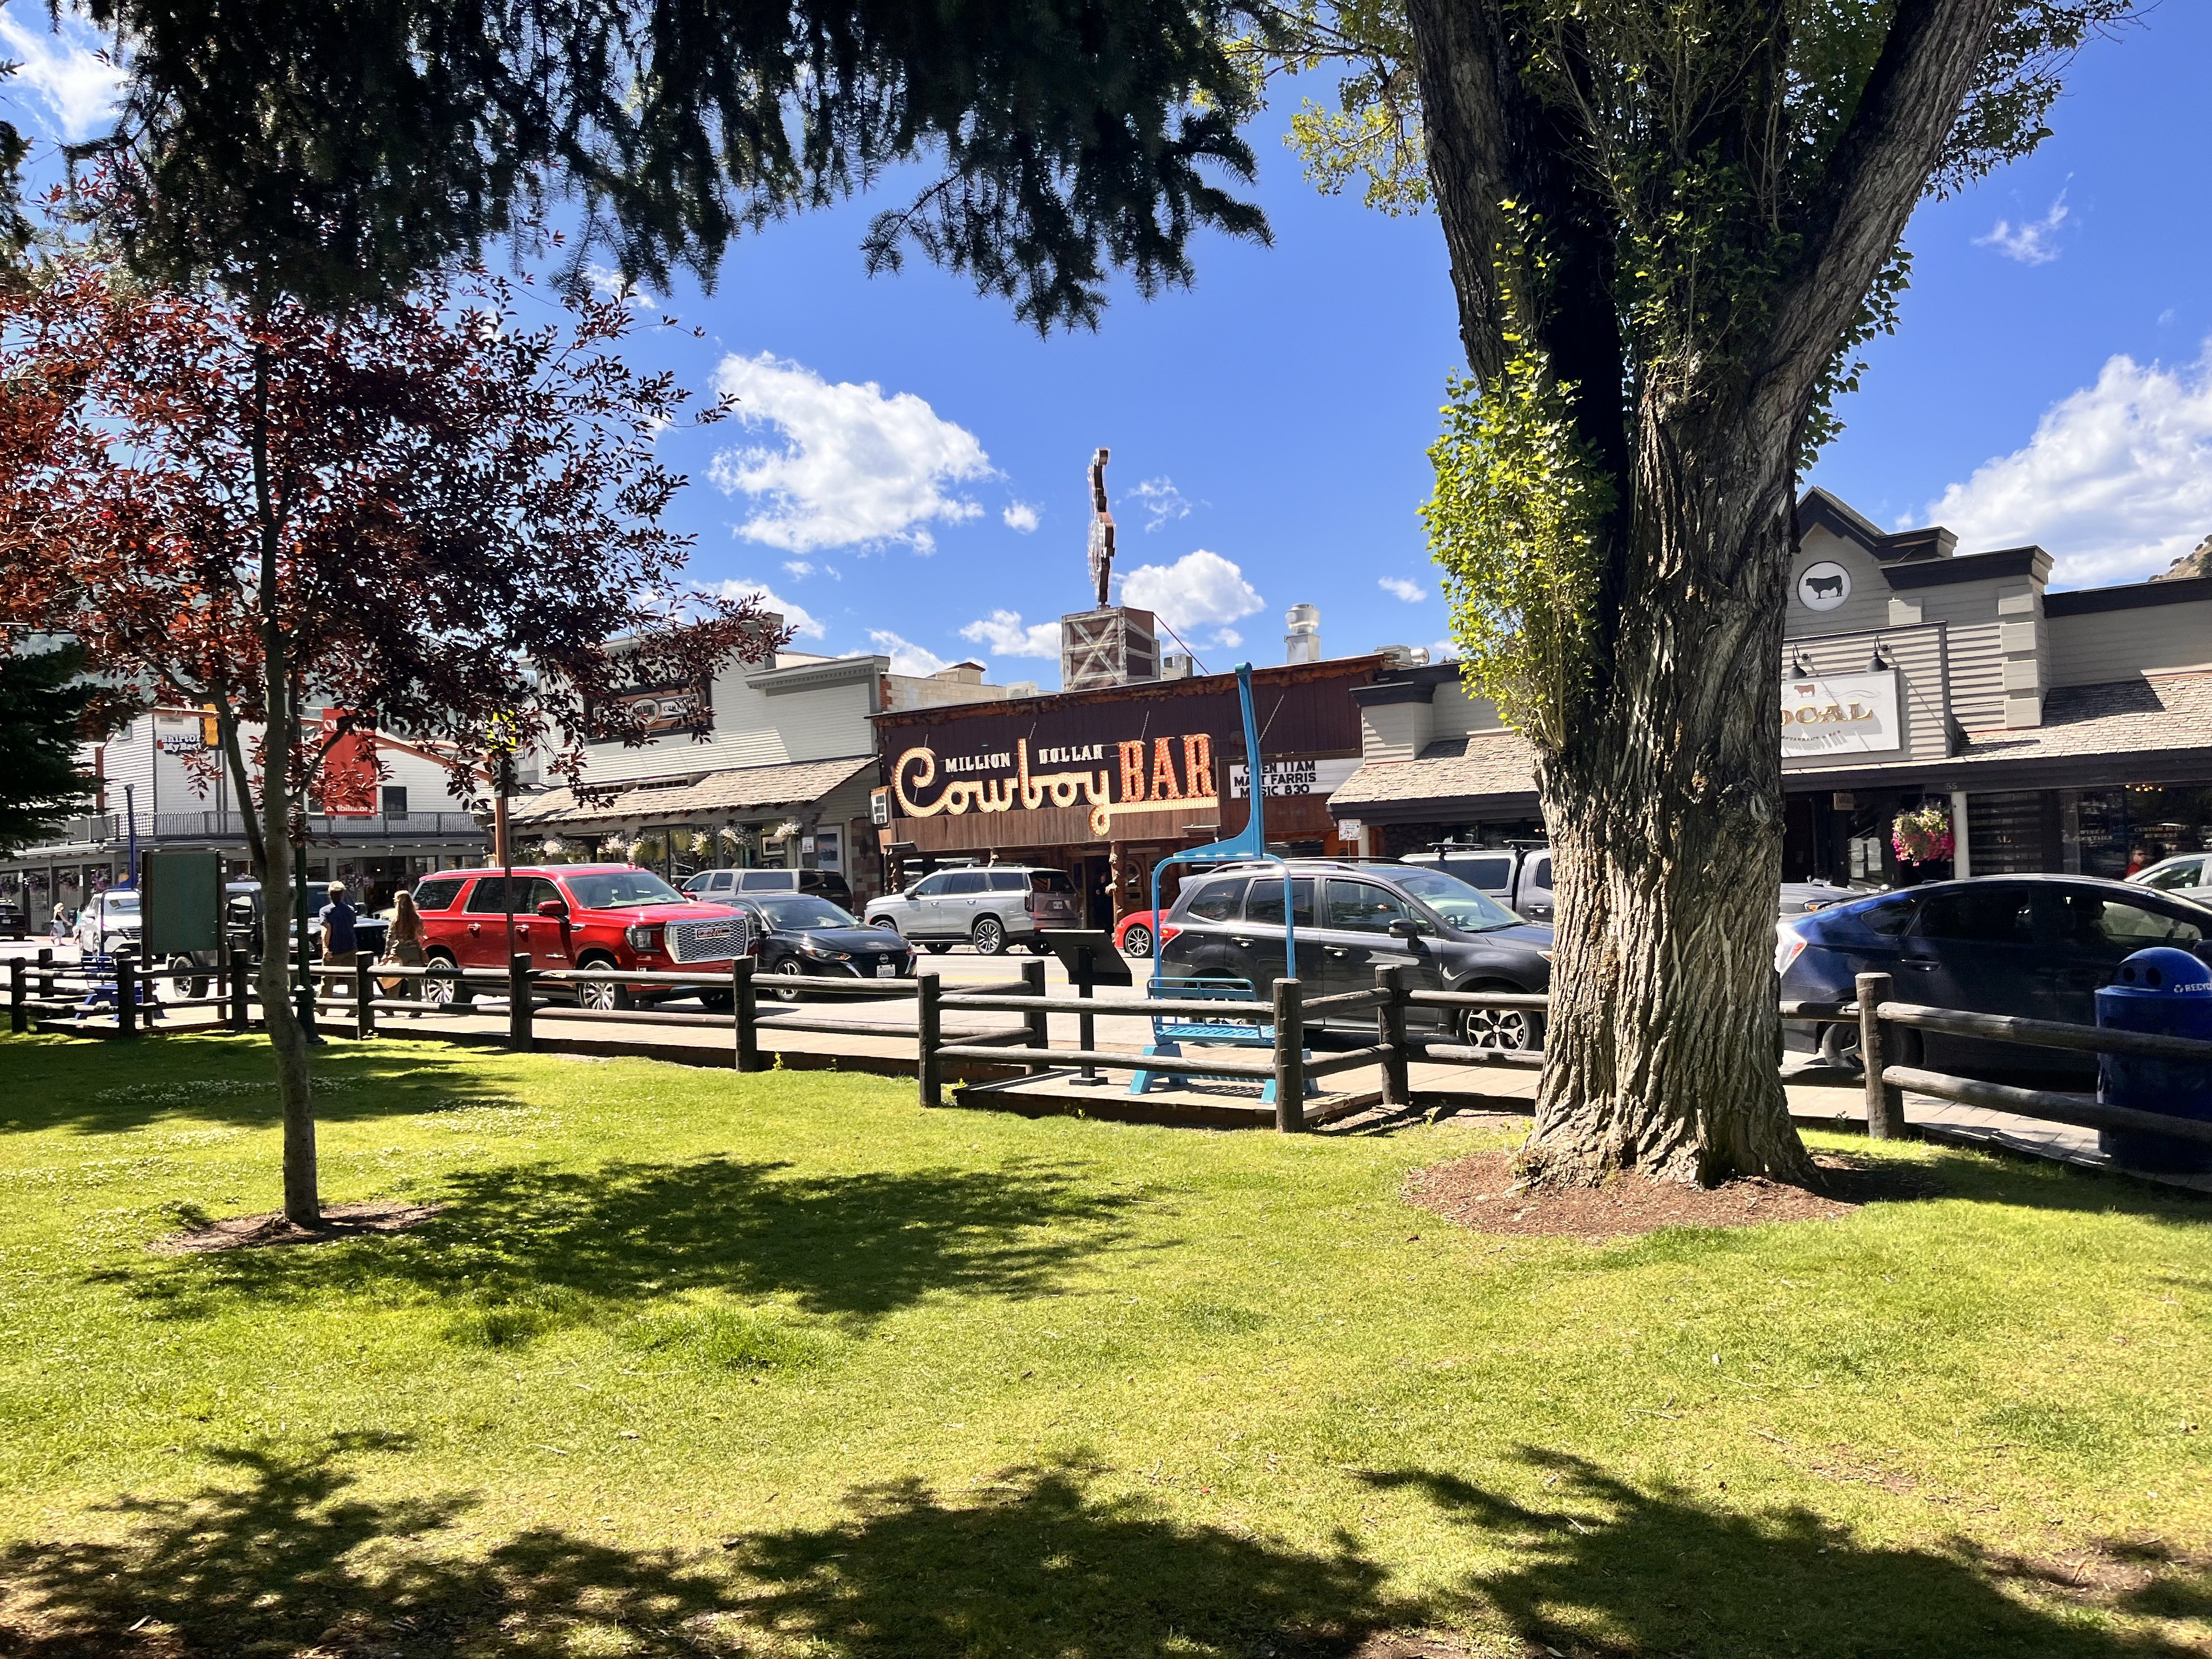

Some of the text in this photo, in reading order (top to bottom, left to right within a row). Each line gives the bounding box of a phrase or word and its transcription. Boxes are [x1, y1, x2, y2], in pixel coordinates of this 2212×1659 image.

[1781, 702, 1873, 727] OCAL
[945, 744, 1109, 772] MILLION DOLLAR
[1243, 760, 1315, 774] OEN 11AM
[894, 733, 1218, 836] Cowboy BAR
[1234, 772, 1316, 787] MAT FARRIS
[1240, 783, 1310, 797] MSIC 830
